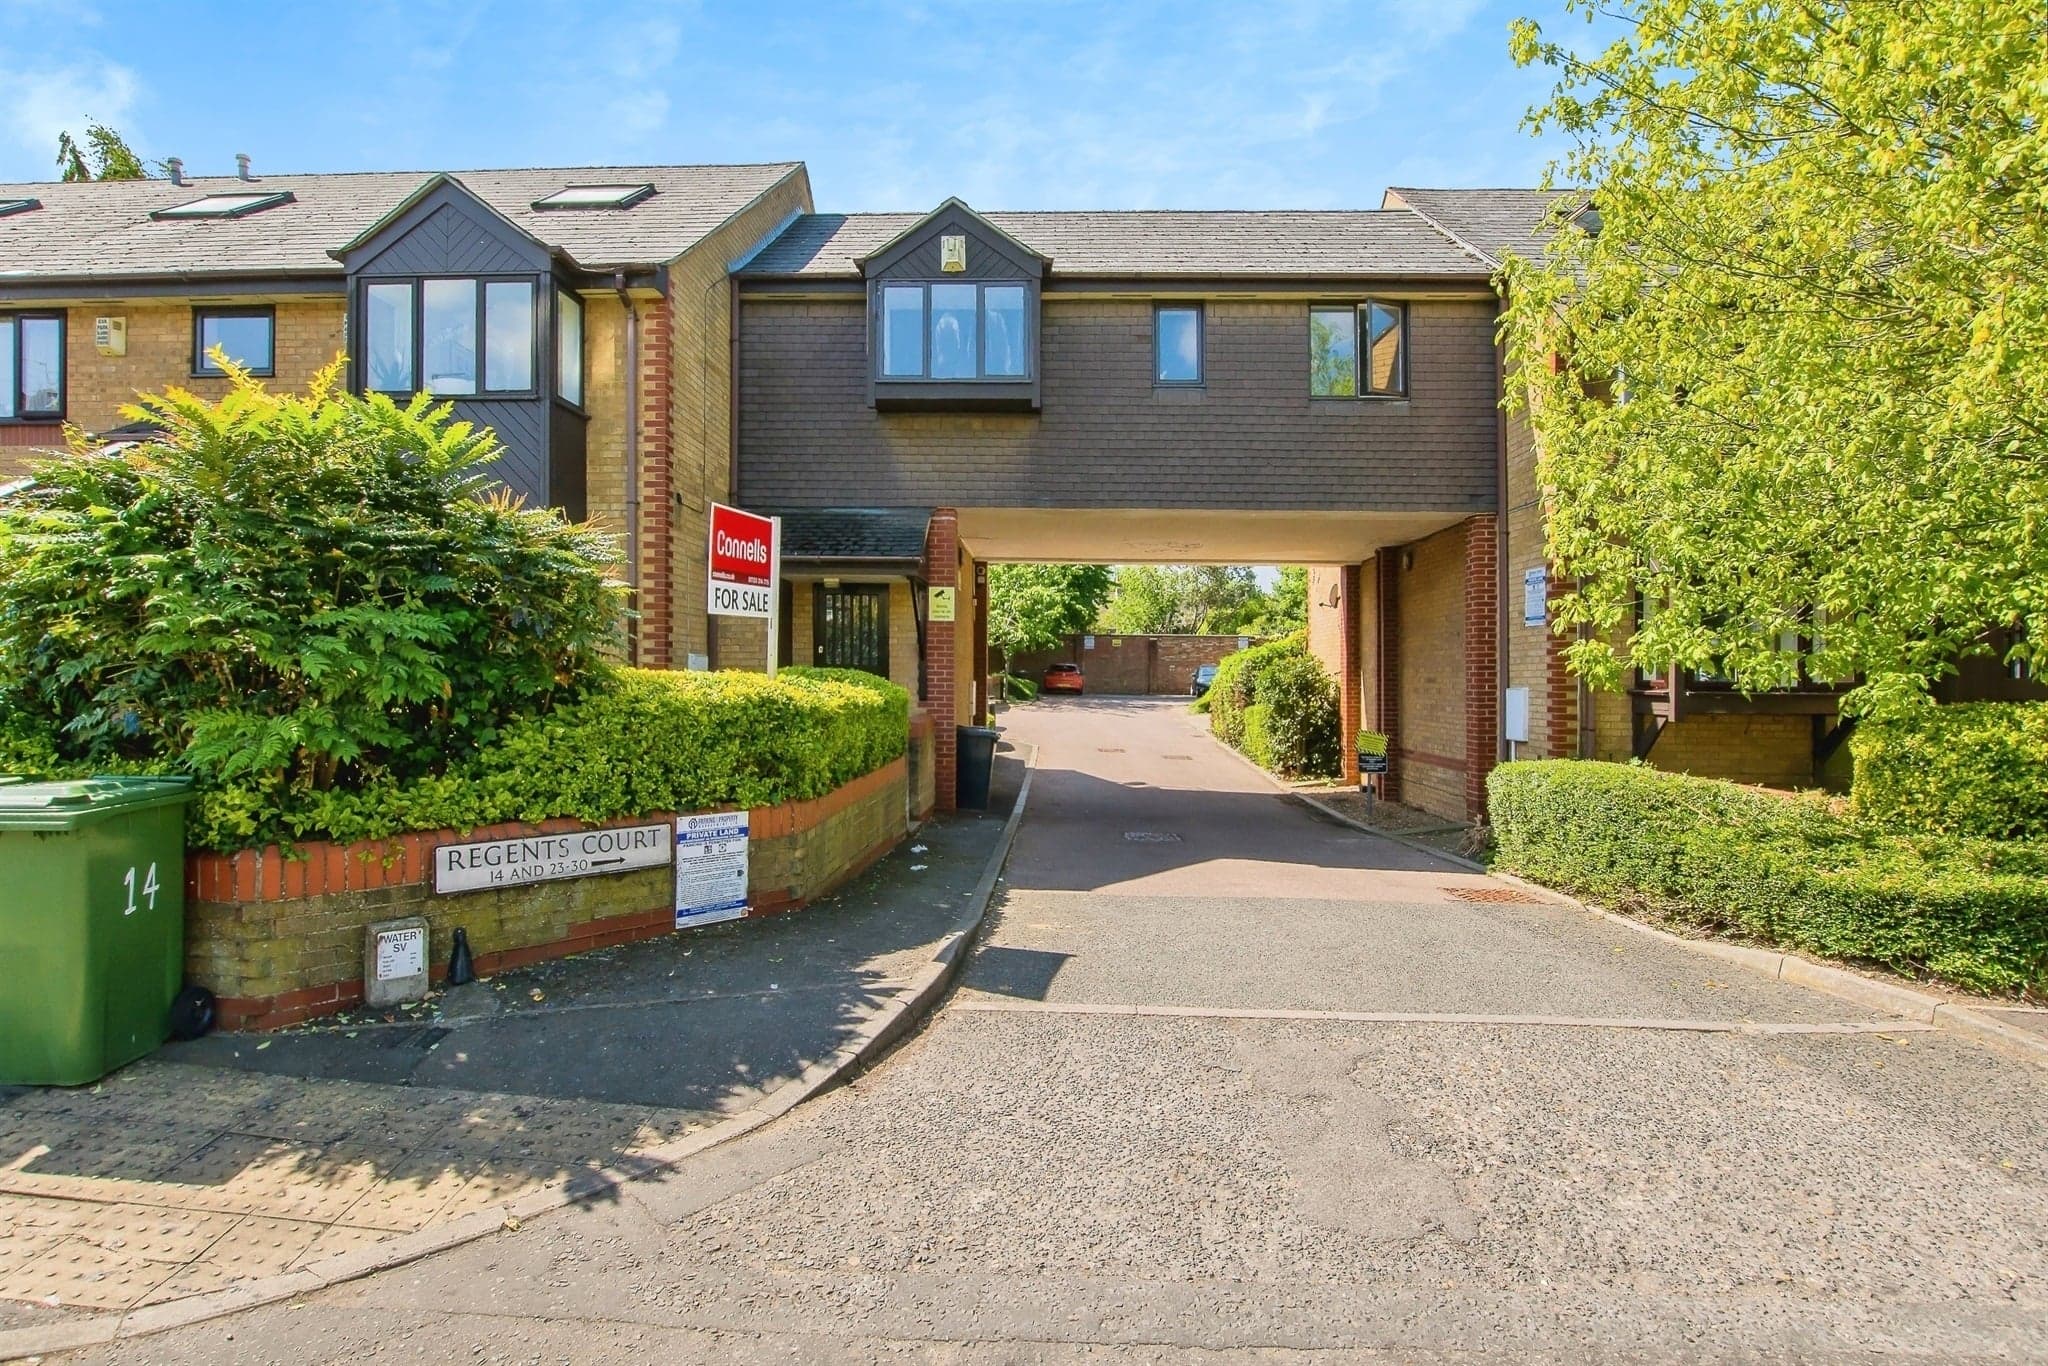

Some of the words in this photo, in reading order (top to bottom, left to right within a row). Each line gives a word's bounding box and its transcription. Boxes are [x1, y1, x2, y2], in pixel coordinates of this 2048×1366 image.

[716, 530, 767, 563] Connells
[714, 587, 739, 610] FOR
[742, 591, 768, 612] SALE
[686, 830, 717, 840] PRIVATE
[719, 828, 739, 836] LAND
[448, 839, 570, 872] REGENTS
[581, 829, 661, 855] COURT
[490, 871, 504, 883] 14
[510, 864, 544, 880] AND
[550, 859, 588, 877] 23-30
[124, 861, 160, 915] 14
[382, 931, 417, 943] WATER
[393, 942, 407, 952] SV
